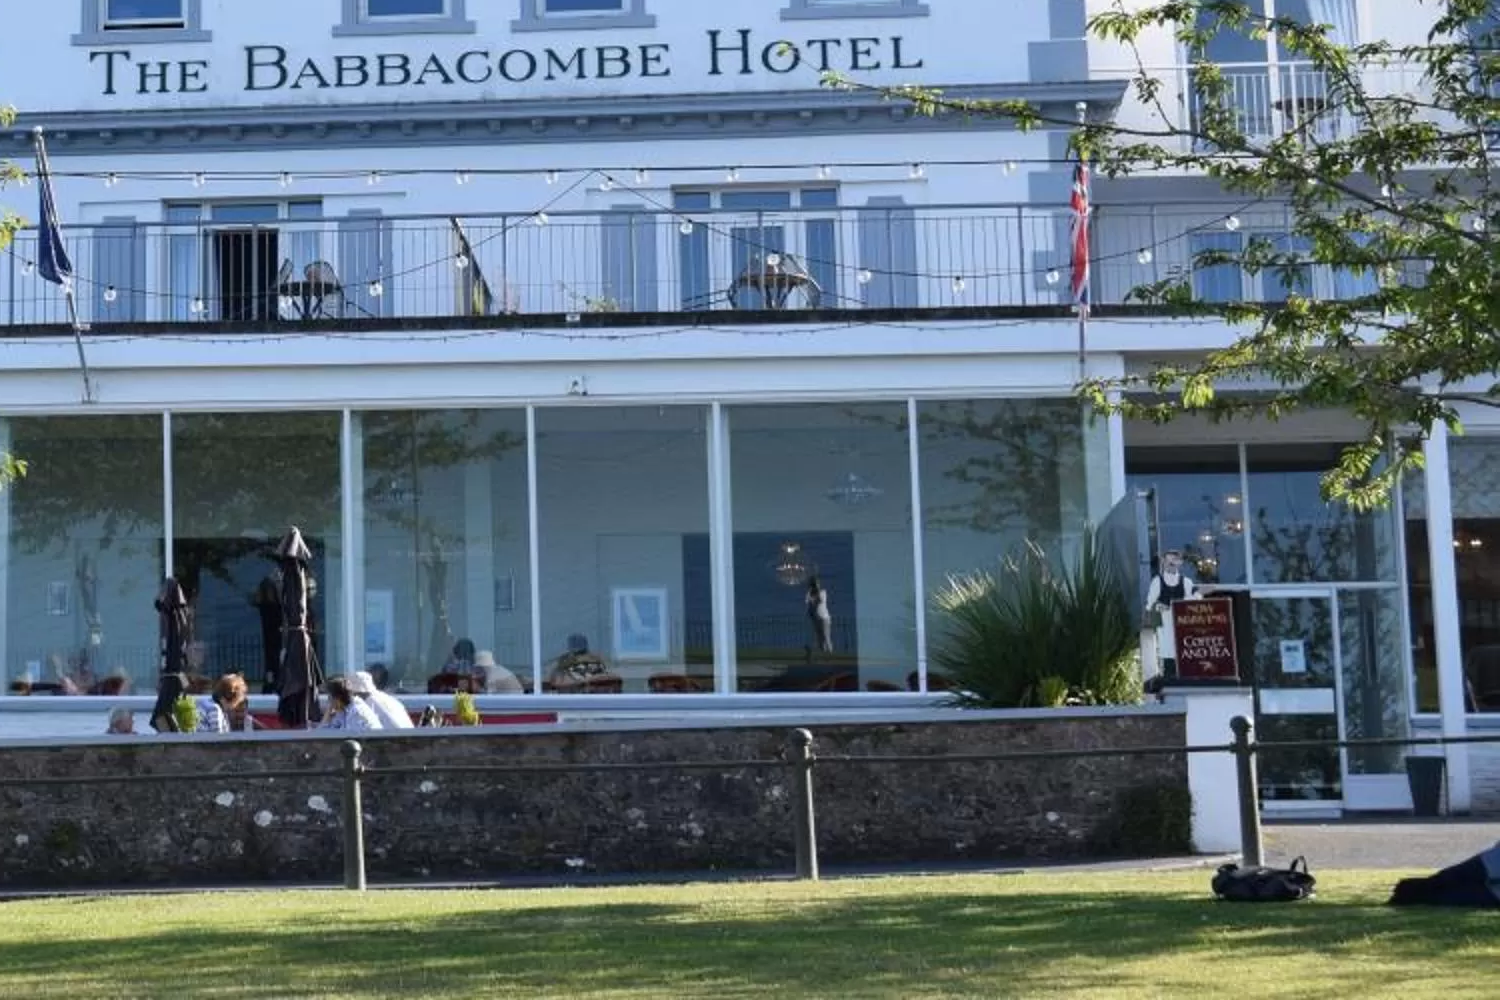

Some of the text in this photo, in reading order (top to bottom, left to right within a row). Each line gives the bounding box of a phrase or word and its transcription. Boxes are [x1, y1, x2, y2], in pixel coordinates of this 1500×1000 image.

[89, 28, 923, 95] THE BABBACOMBE HOTEL
